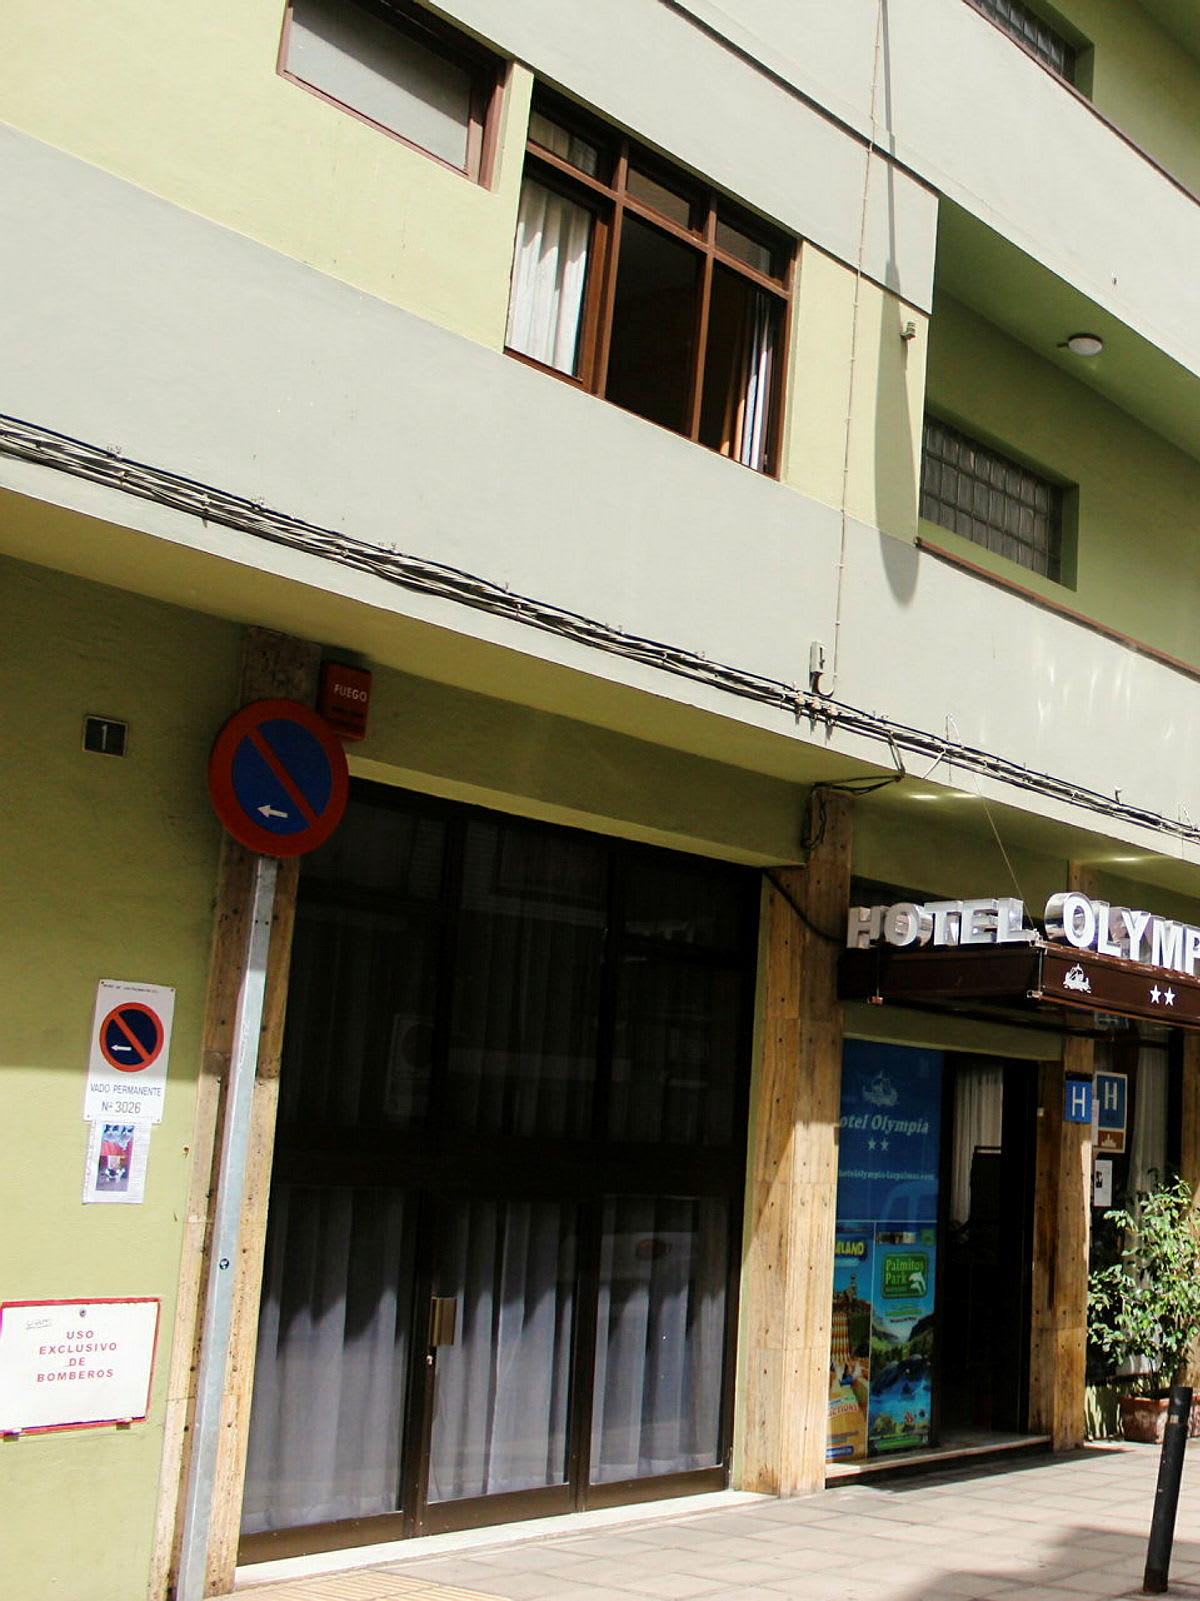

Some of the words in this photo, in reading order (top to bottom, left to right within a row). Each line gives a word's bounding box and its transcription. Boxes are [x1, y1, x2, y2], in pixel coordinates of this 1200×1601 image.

[334, 683, 368, 702] FUEGO
[101, 723, 108, 750] 1
[847, 897, 1031, 949] HOTEL
[90, 1083, 110, 1093] VADO
[113, 1084, 162, 1097] PERMANENTE
[1104, 1081, 1118, 1111] H
[115, 1101, 141, 1114] 3026
[1071, 1086, 1086, 1118] H
[840, 1114, 869, 1130] otel
[871, 1114, 929, 1136] Olympia
[886, 1259, 924, 1271] Palmitos
[886, 1273, 908, 1285] Park
[66, 1330, 94, 1340] USO
[39, 1342, 117, 1355] EXCLUSIVO
[69, 1357, 86, 1367] DE
[37, 1369, 114, 1382] BOMBEROS
